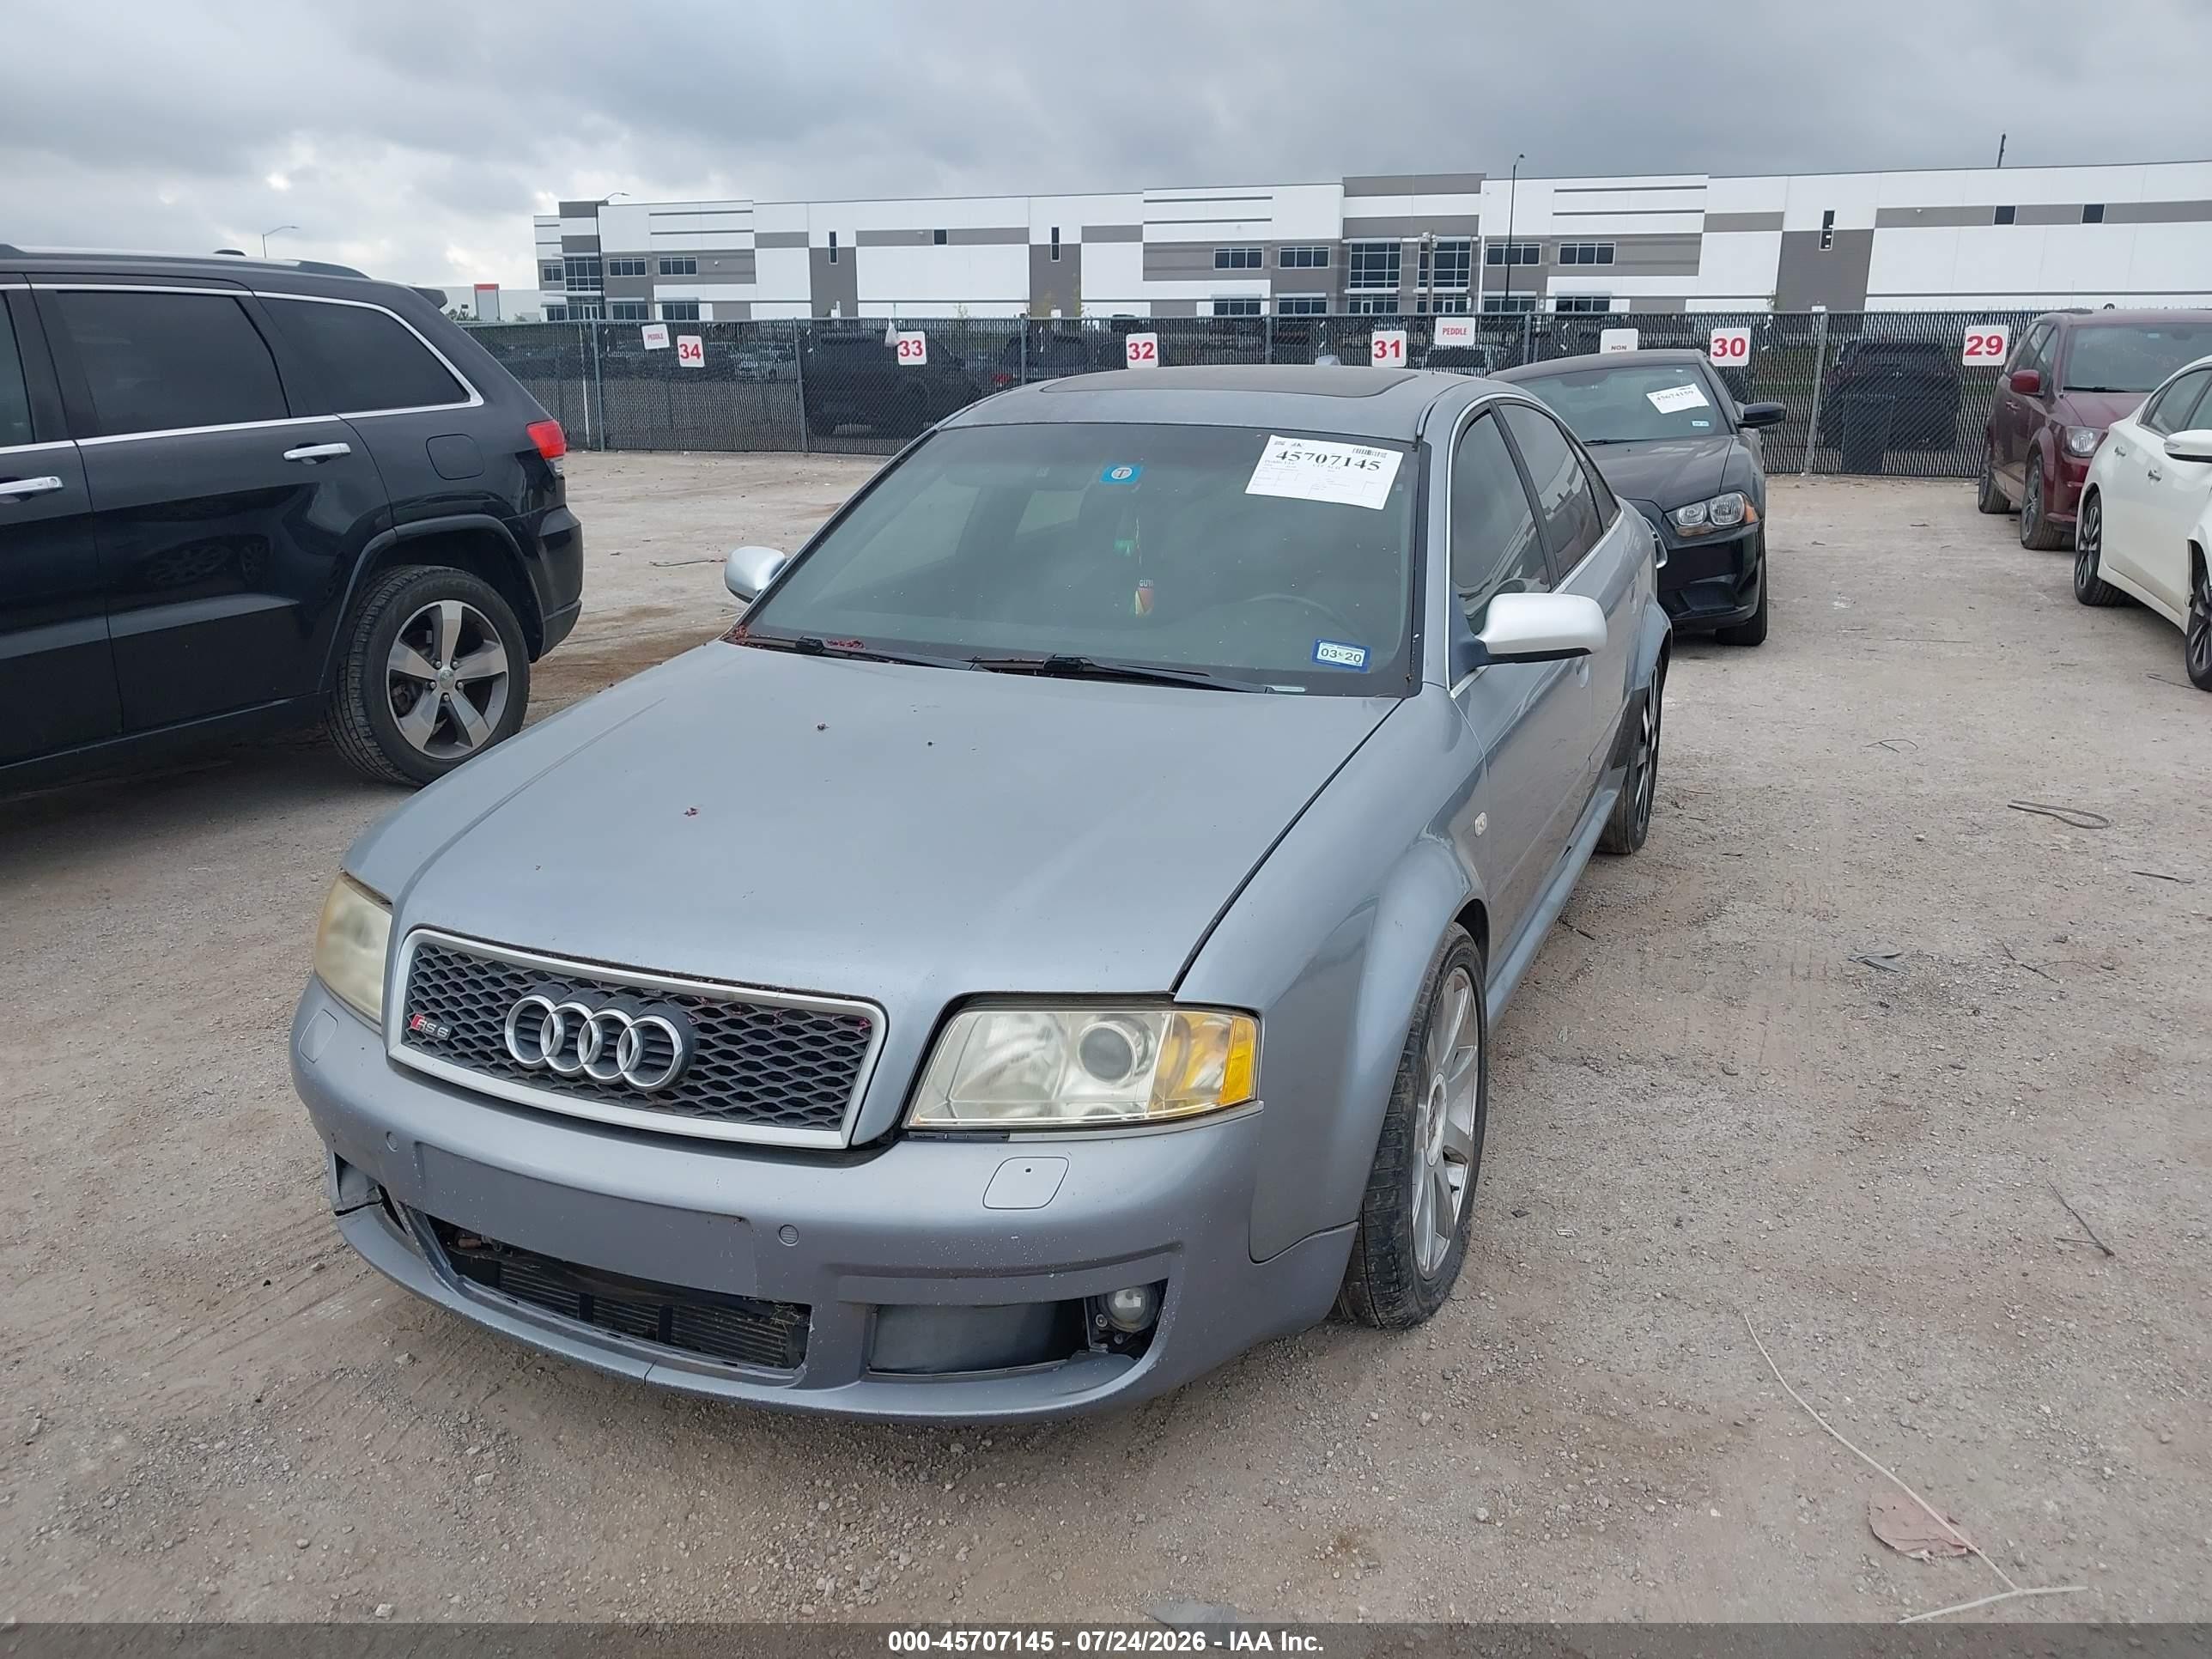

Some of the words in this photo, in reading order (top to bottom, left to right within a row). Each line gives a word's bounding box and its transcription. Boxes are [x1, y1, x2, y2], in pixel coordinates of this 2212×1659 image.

[1443, 327, 1467, 336] PEDDLE
[679, 343, 701, 359] 34
[899, 340, 923, 357] 33
[1128, 342, 1155, 361] 32
[1374, 339, 1401, 358] 31
[1712, 337, 1746, 357] 30
[1965, 336, 2003, 356] 29
[1275, 450, 1382, 471] 45707145
[1321, 648, 1337, 659] 03
[1345, 653, 1362, 663] 20
